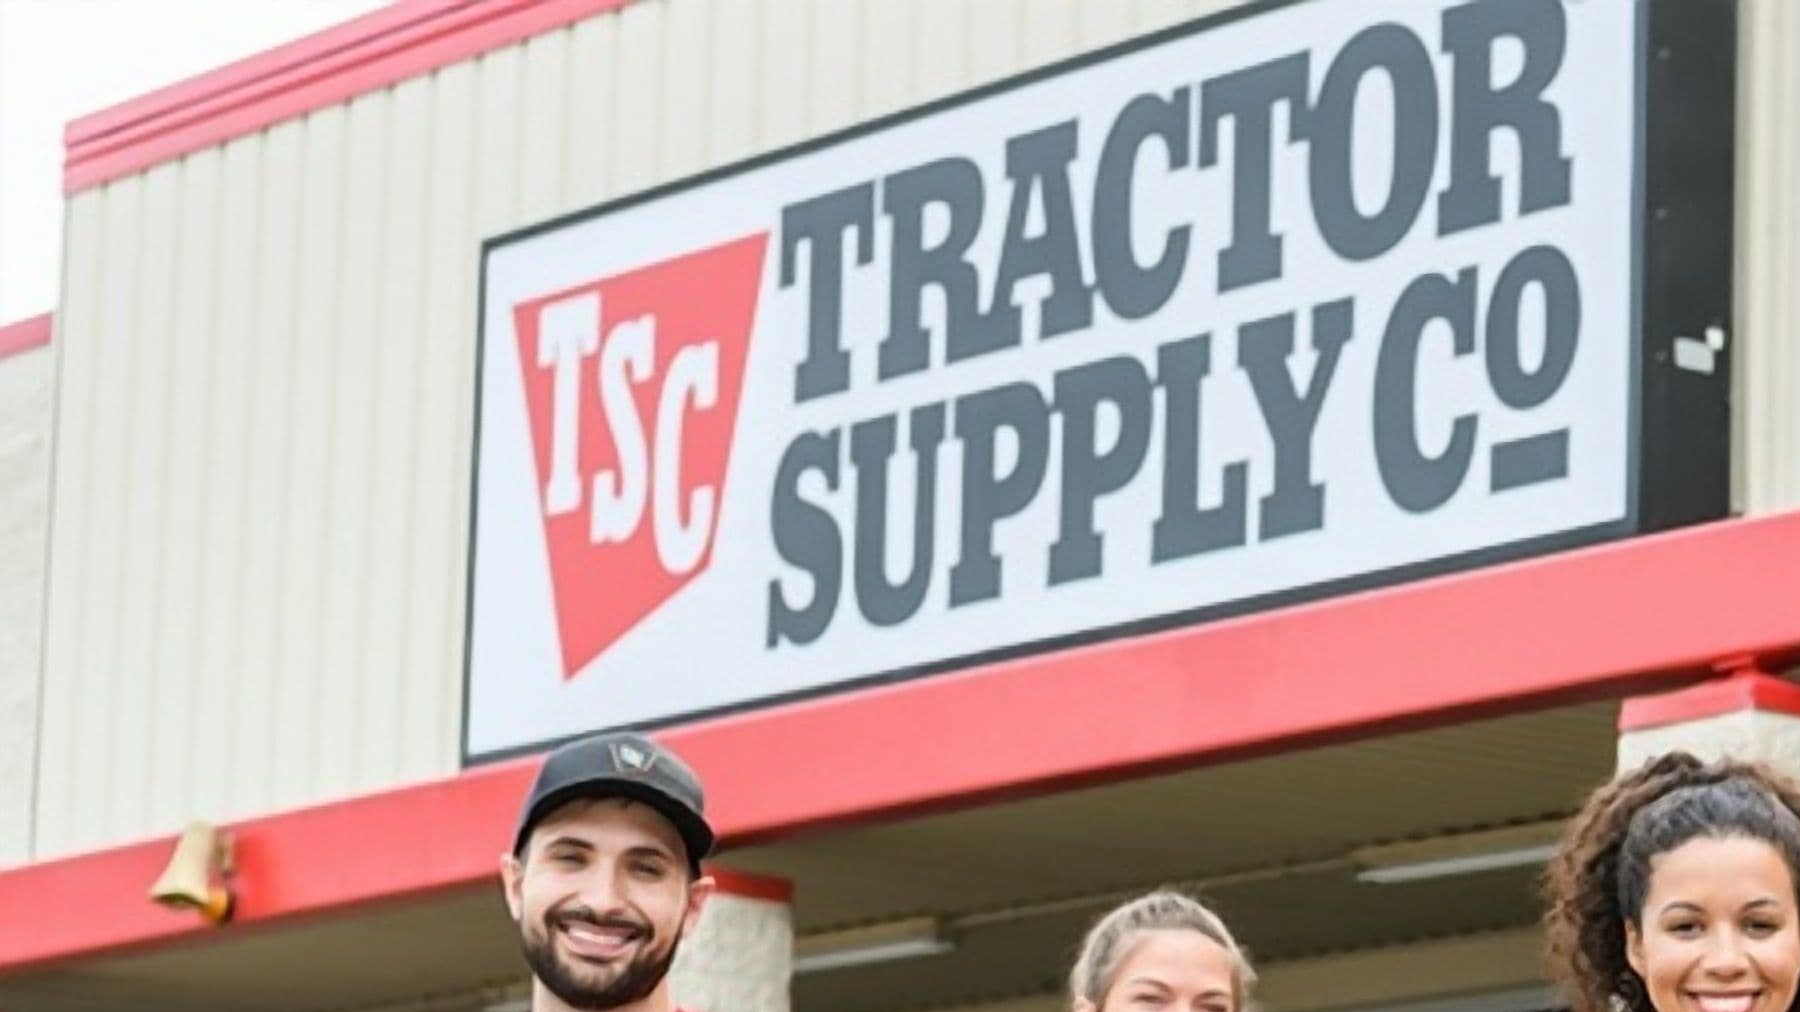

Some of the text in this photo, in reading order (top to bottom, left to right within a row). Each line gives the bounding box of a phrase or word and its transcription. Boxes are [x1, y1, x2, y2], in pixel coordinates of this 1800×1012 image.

[780, 0, 1572, 403] TRACTOR
[538, 292, 719, 575] TSC
[767, 297, 1355, 648] SUPPLY
